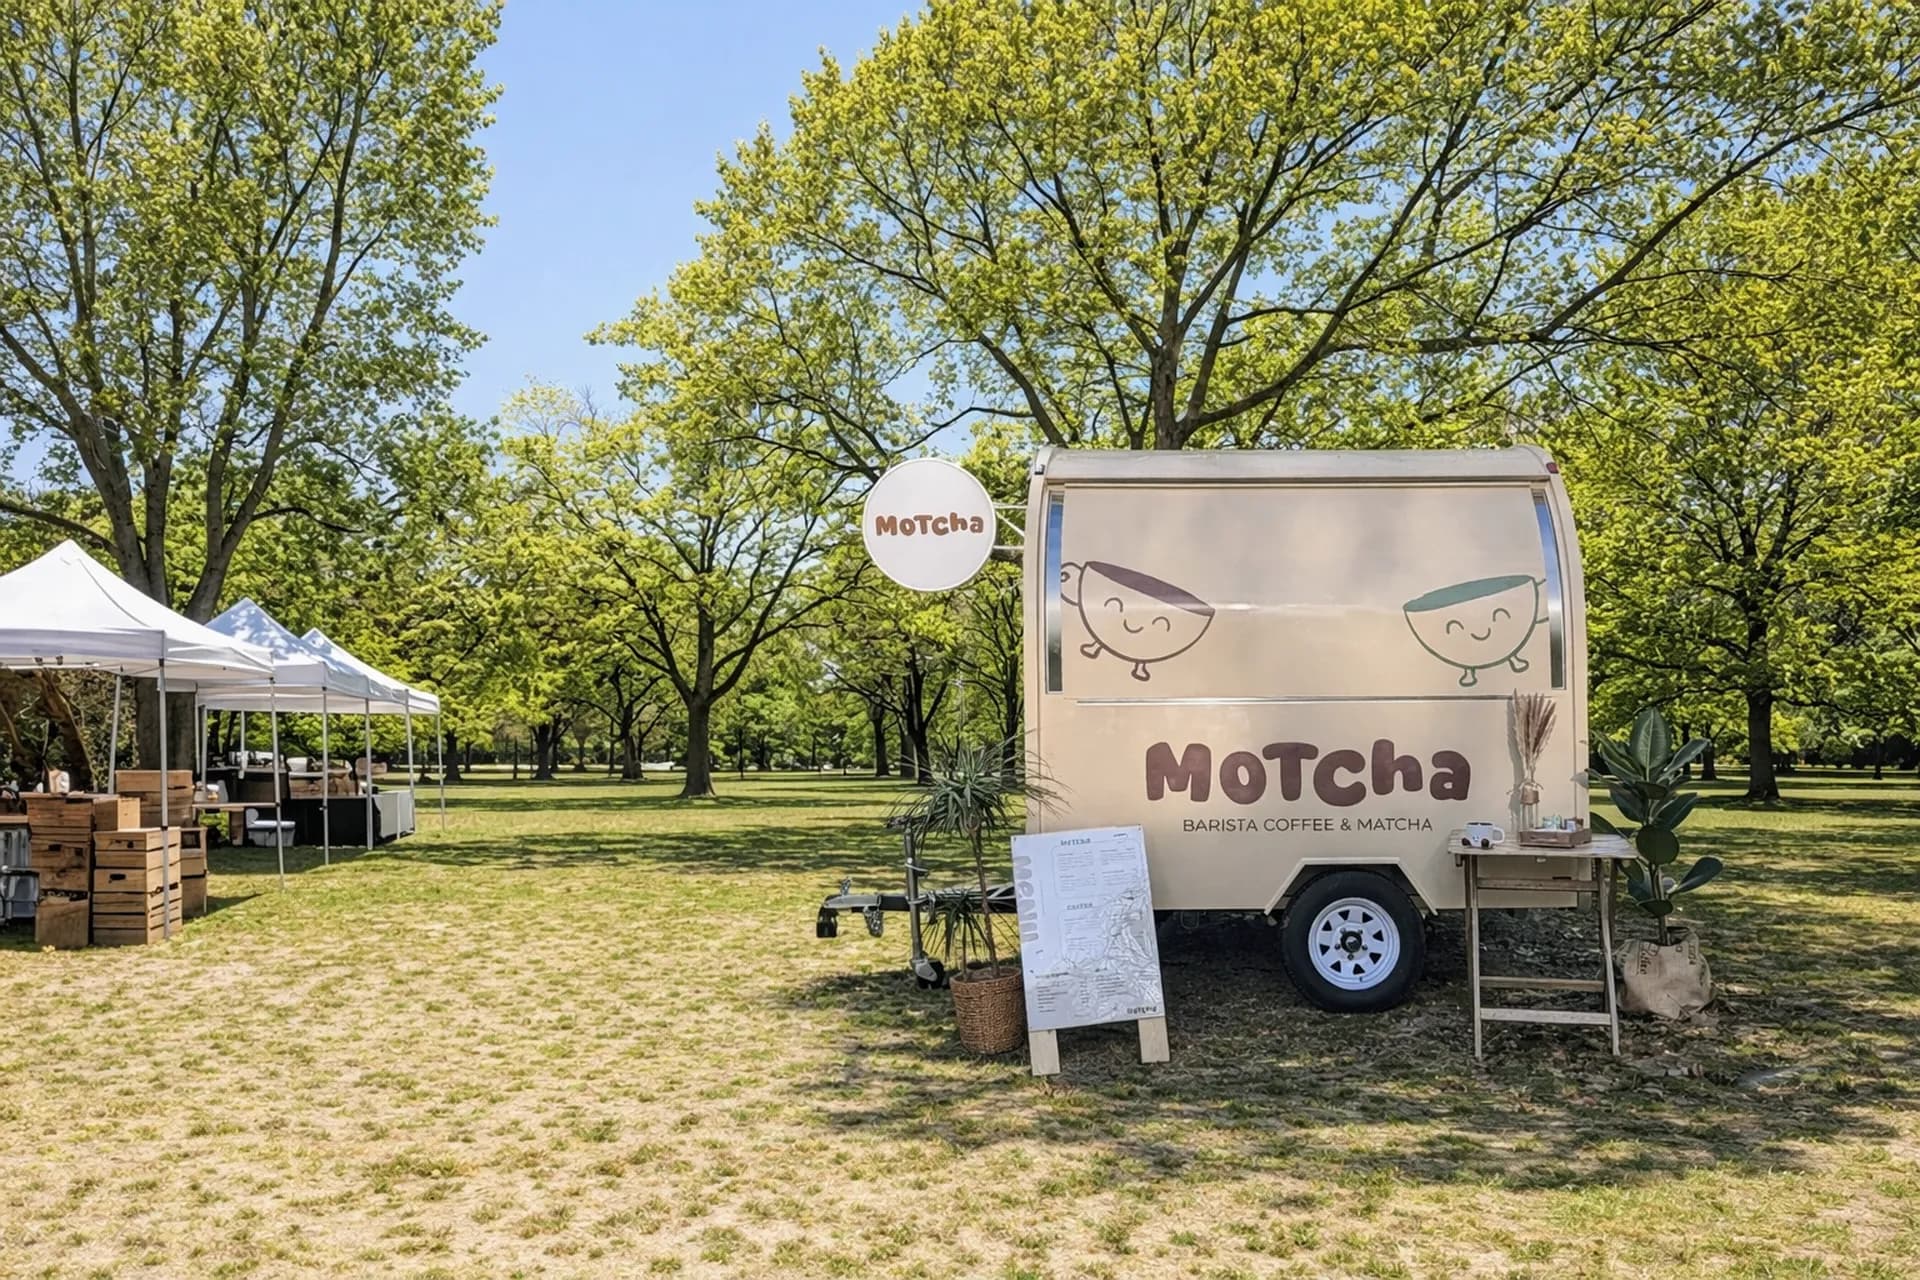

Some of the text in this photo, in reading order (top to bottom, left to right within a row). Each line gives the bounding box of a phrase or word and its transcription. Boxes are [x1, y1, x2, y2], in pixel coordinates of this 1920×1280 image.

[875, 512, 984, 536] MoTcha
[1145, 738, 1471, 807] MoTcha
[1183, 817, 1433, 832] BARISTA COFFEE & MATCHA
